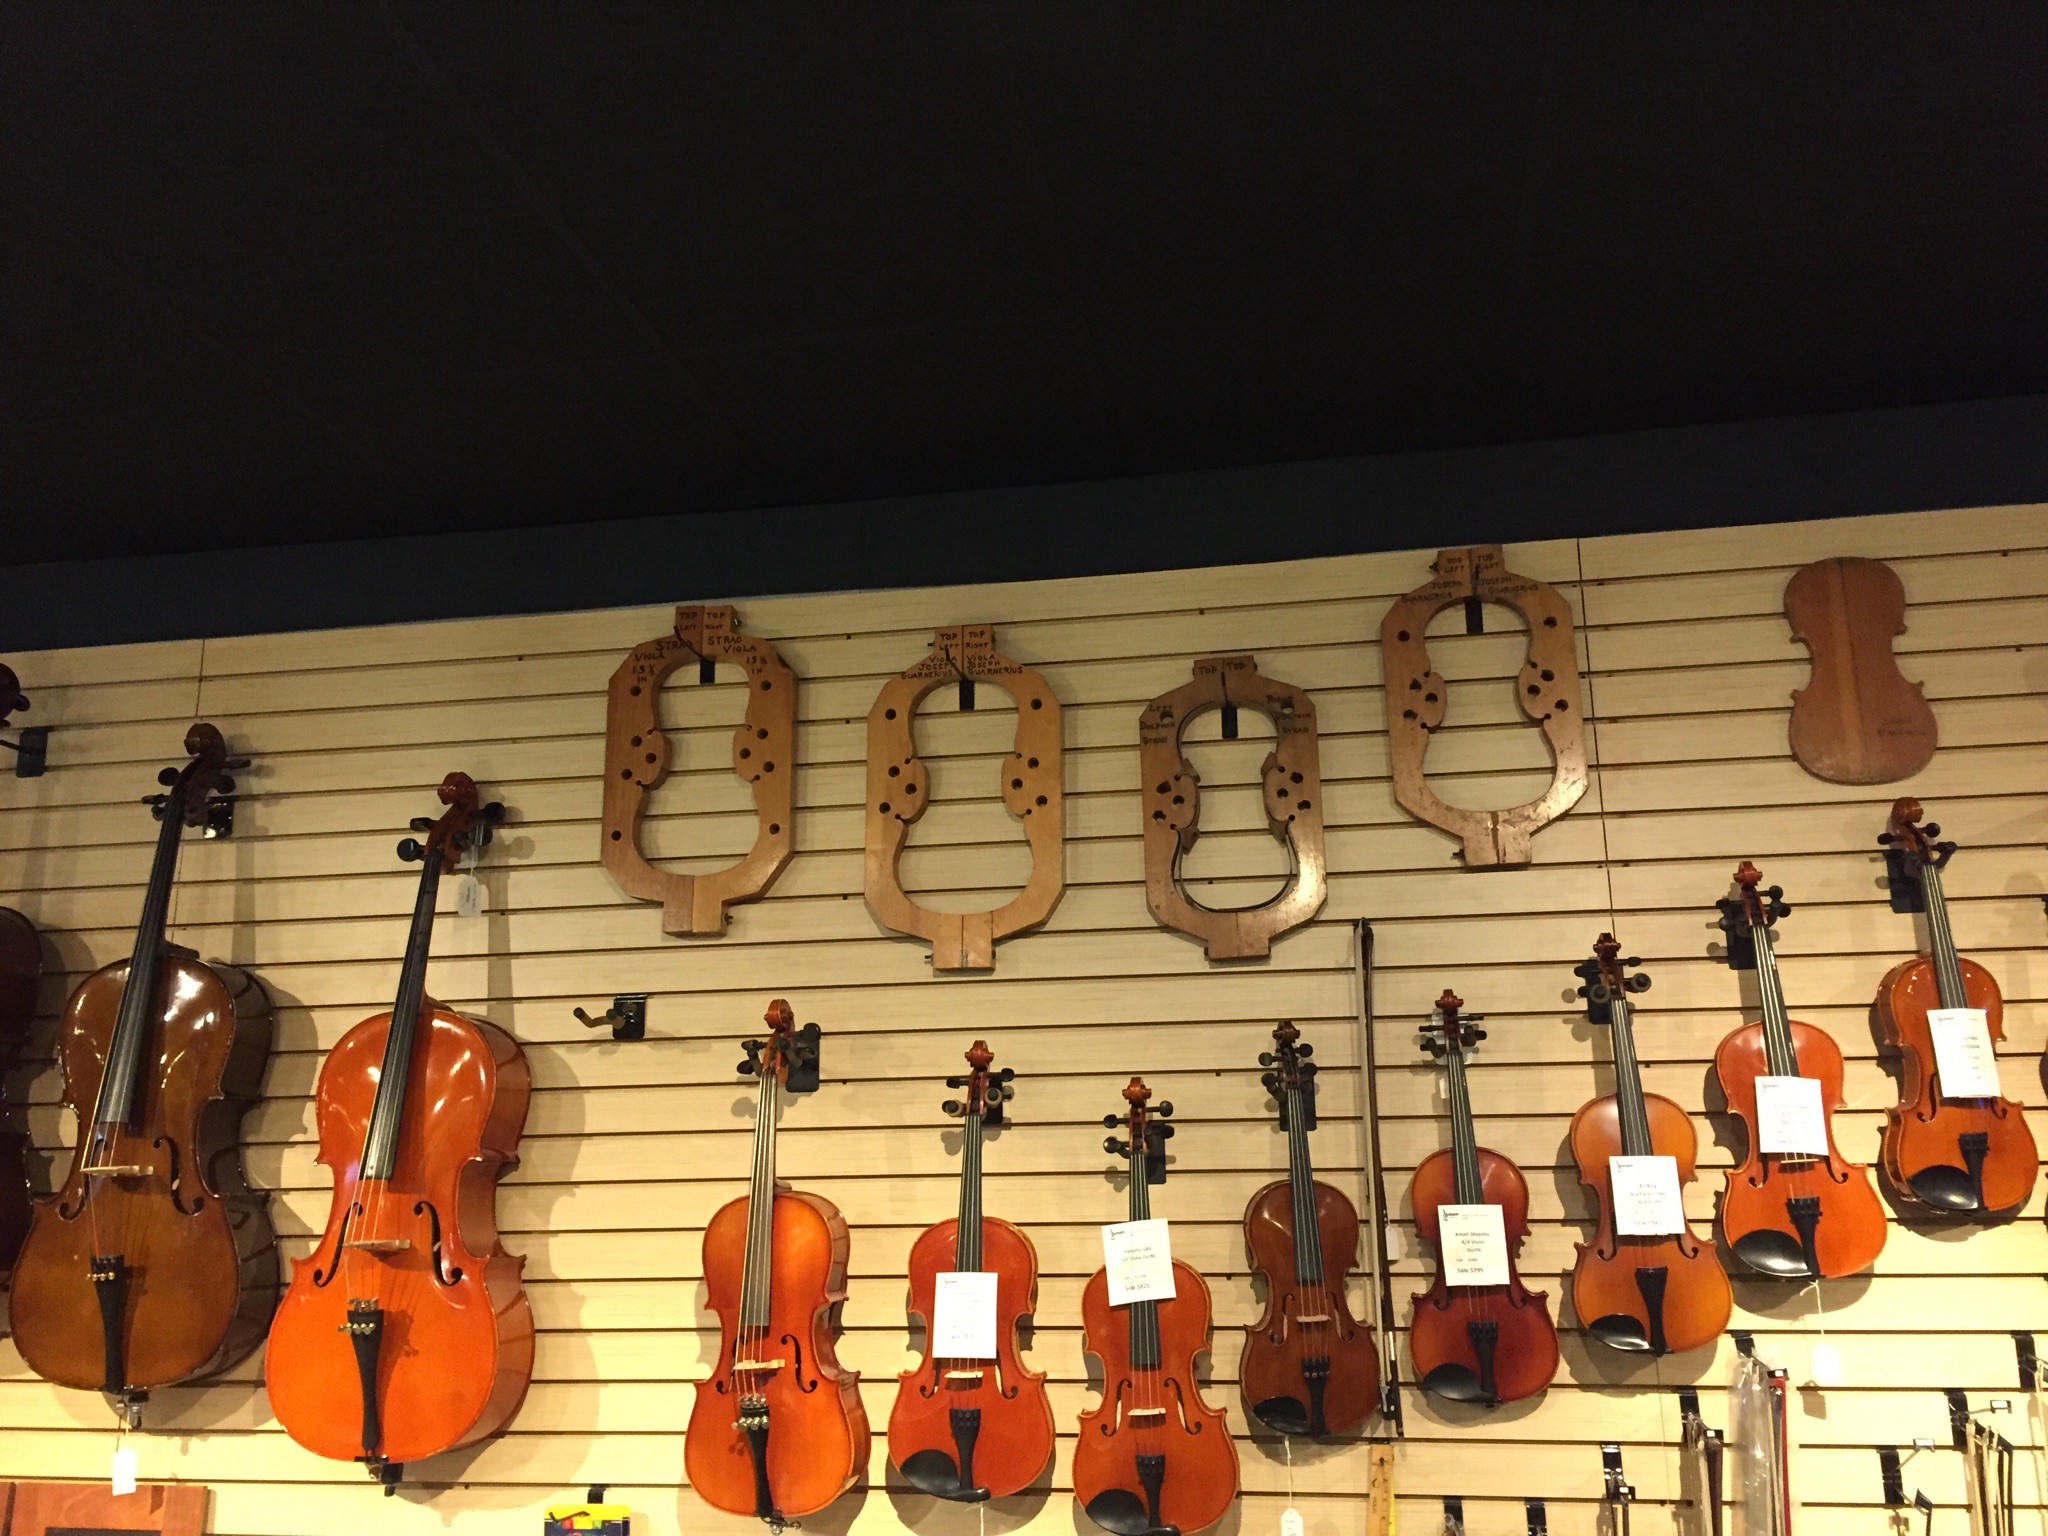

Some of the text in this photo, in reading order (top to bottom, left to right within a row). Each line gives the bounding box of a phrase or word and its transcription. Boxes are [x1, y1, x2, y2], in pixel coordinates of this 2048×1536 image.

[678, 611, 698, 620] TOP
[706, 611, 725, 619] TOP
[940, 632, 958, 641] TOP
[968, 629, 986, 638] TOP
[708, 635, 743, 646] STRAD
[723, 644, 757, 654] VIOLA
[929, 654, 958, 664] VIOA
[965, 653, 996, 661] VIOLA
[966, 660, 1001, 669] JOSEPH
[1226, 662, 1246, 671] TOP
[900, 669, 953, 680] GUARNERIUS
[967, 666, 1023, 676] GUARNERIUS
[1197, 665, 1218, 675] TOP
